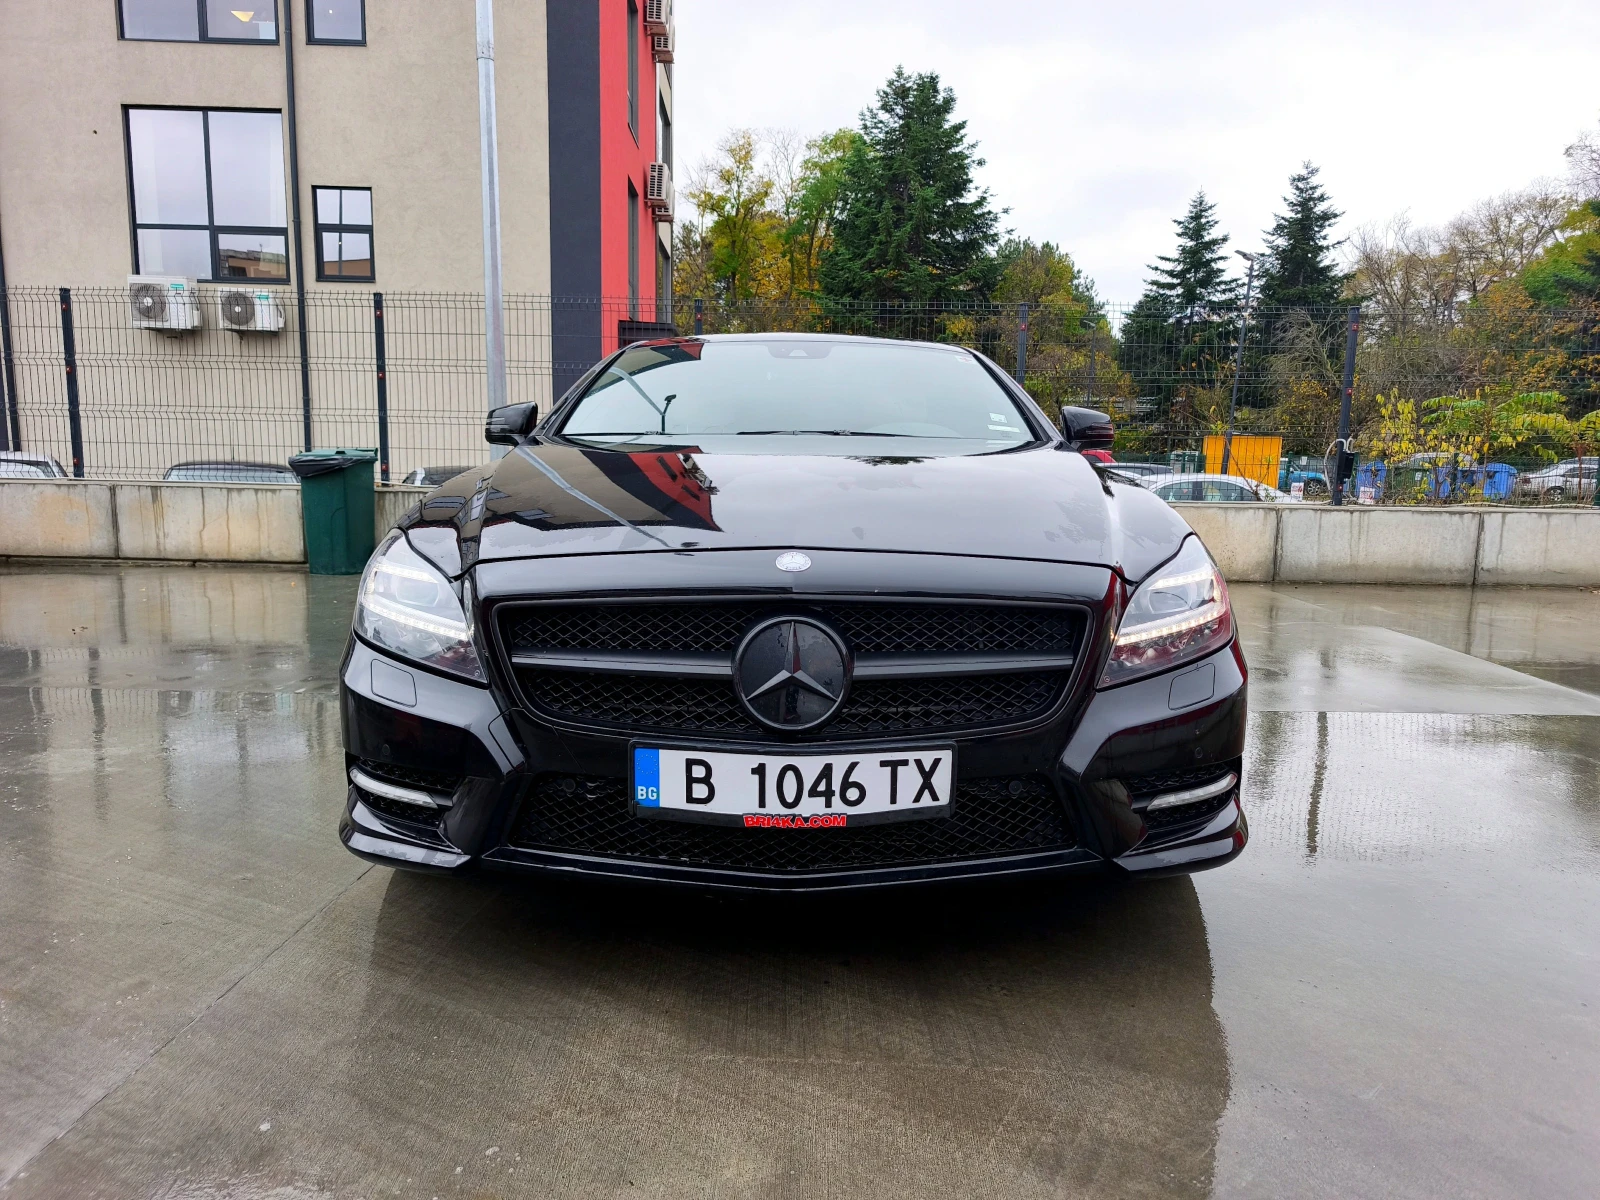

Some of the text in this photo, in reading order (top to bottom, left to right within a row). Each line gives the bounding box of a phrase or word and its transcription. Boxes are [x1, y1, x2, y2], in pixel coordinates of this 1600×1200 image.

[684, 757, 943, 810] B 1046 TX
[637, 785, 658, 800] BG
[743, 814, 847, 828] BRI4KA.COM
